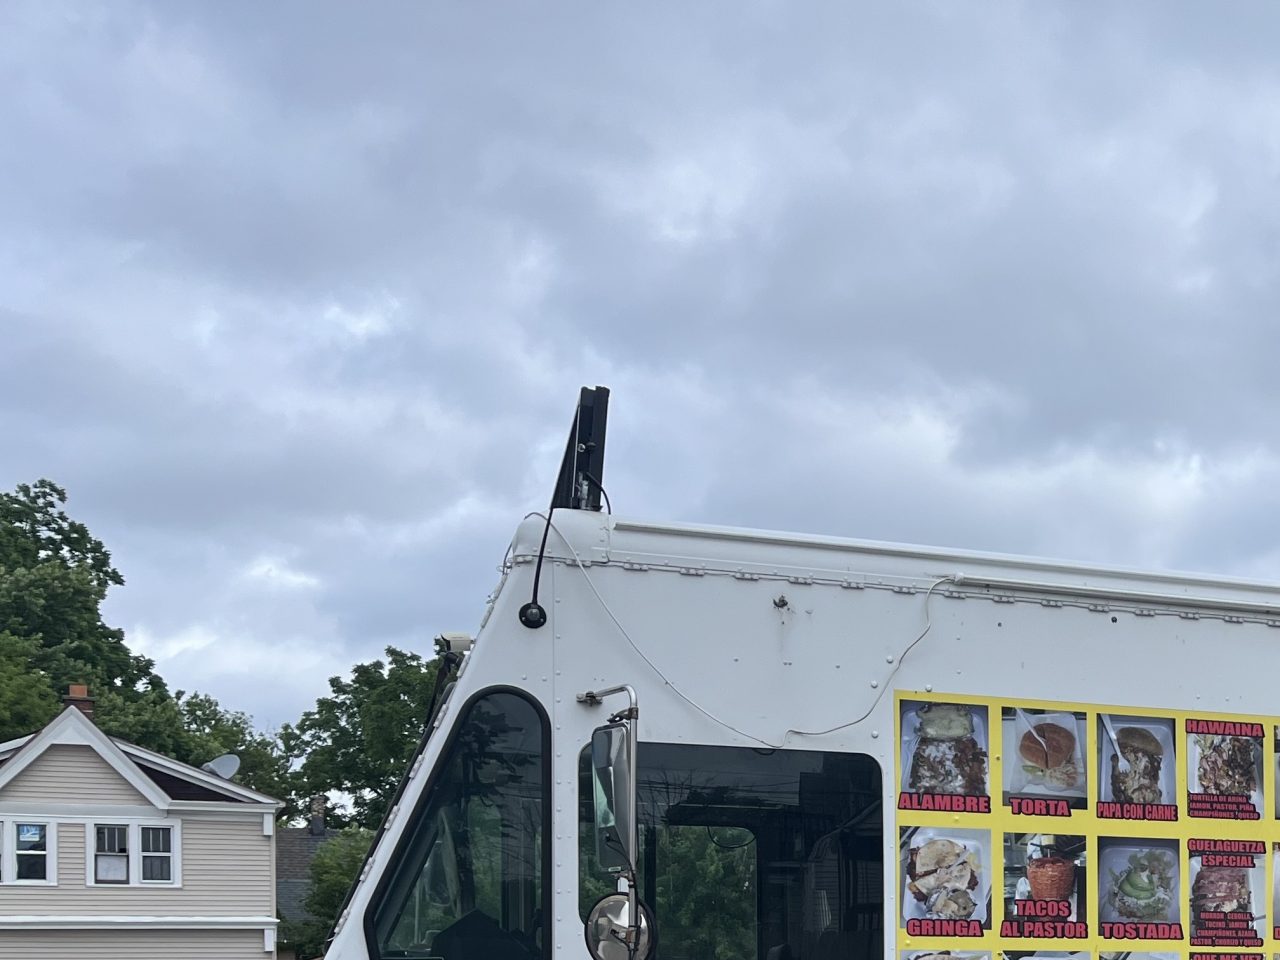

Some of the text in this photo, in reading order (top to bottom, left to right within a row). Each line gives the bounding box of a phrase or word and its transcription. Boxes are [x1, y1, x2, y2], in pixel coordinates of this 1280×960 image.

[1187, 720, 1264, 737] HAWAINA
[899, 793, 990, 813] ALAMBRE
[1010, 798, 1071, 816] TORTA
[1098, 802, 1177, 820] PAPA CON CARNE
[1188, 839, 1265, 853] GUELAGUETZA
[1202, 855, 1255, 867] ESPECIAL
[1016, 900, 1070, 917] TACOS
[907, 919, 983, 937] GRINGA
[1001, 921, 1087, 938] AL PASTOR
[1101, 923, 1183, 939] TOSTADA
